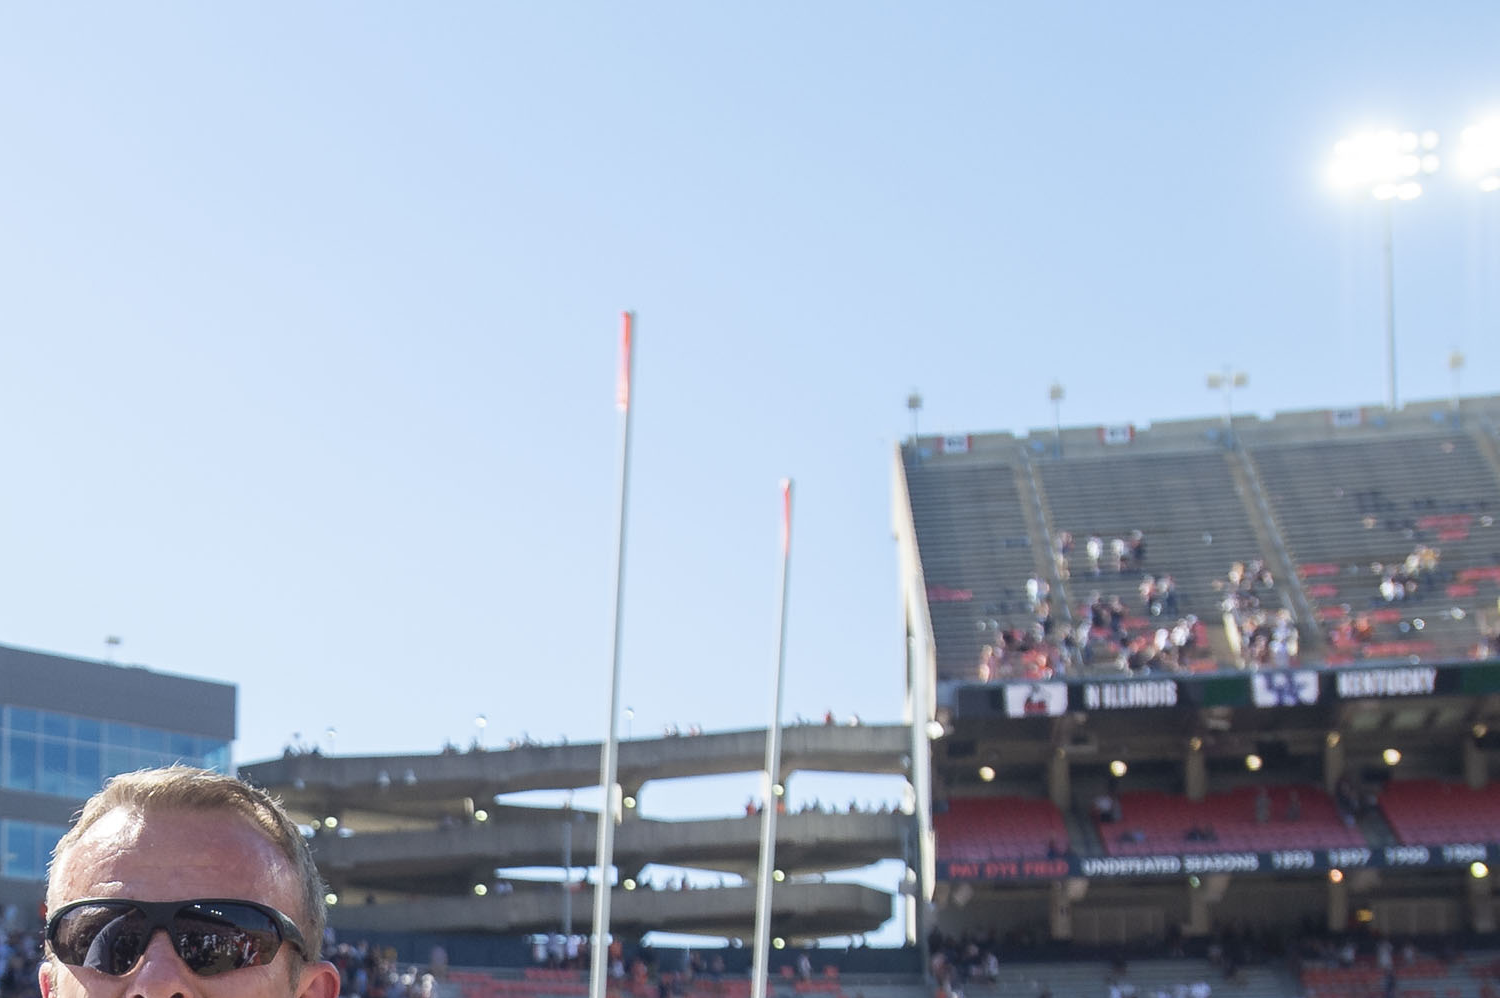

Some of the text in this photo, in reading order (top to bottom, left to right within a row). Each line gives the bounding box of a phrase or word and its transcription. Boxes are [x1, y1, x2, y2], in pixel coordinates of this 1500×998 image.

[1102, 678, 1179, 709] ILLINOIS
[1336, 664, 1438, 698] KENTUCKY
[1080, 855, 1182, 876] UNDEFEATED
[1183, 851, 1260, 874] SEASONS
